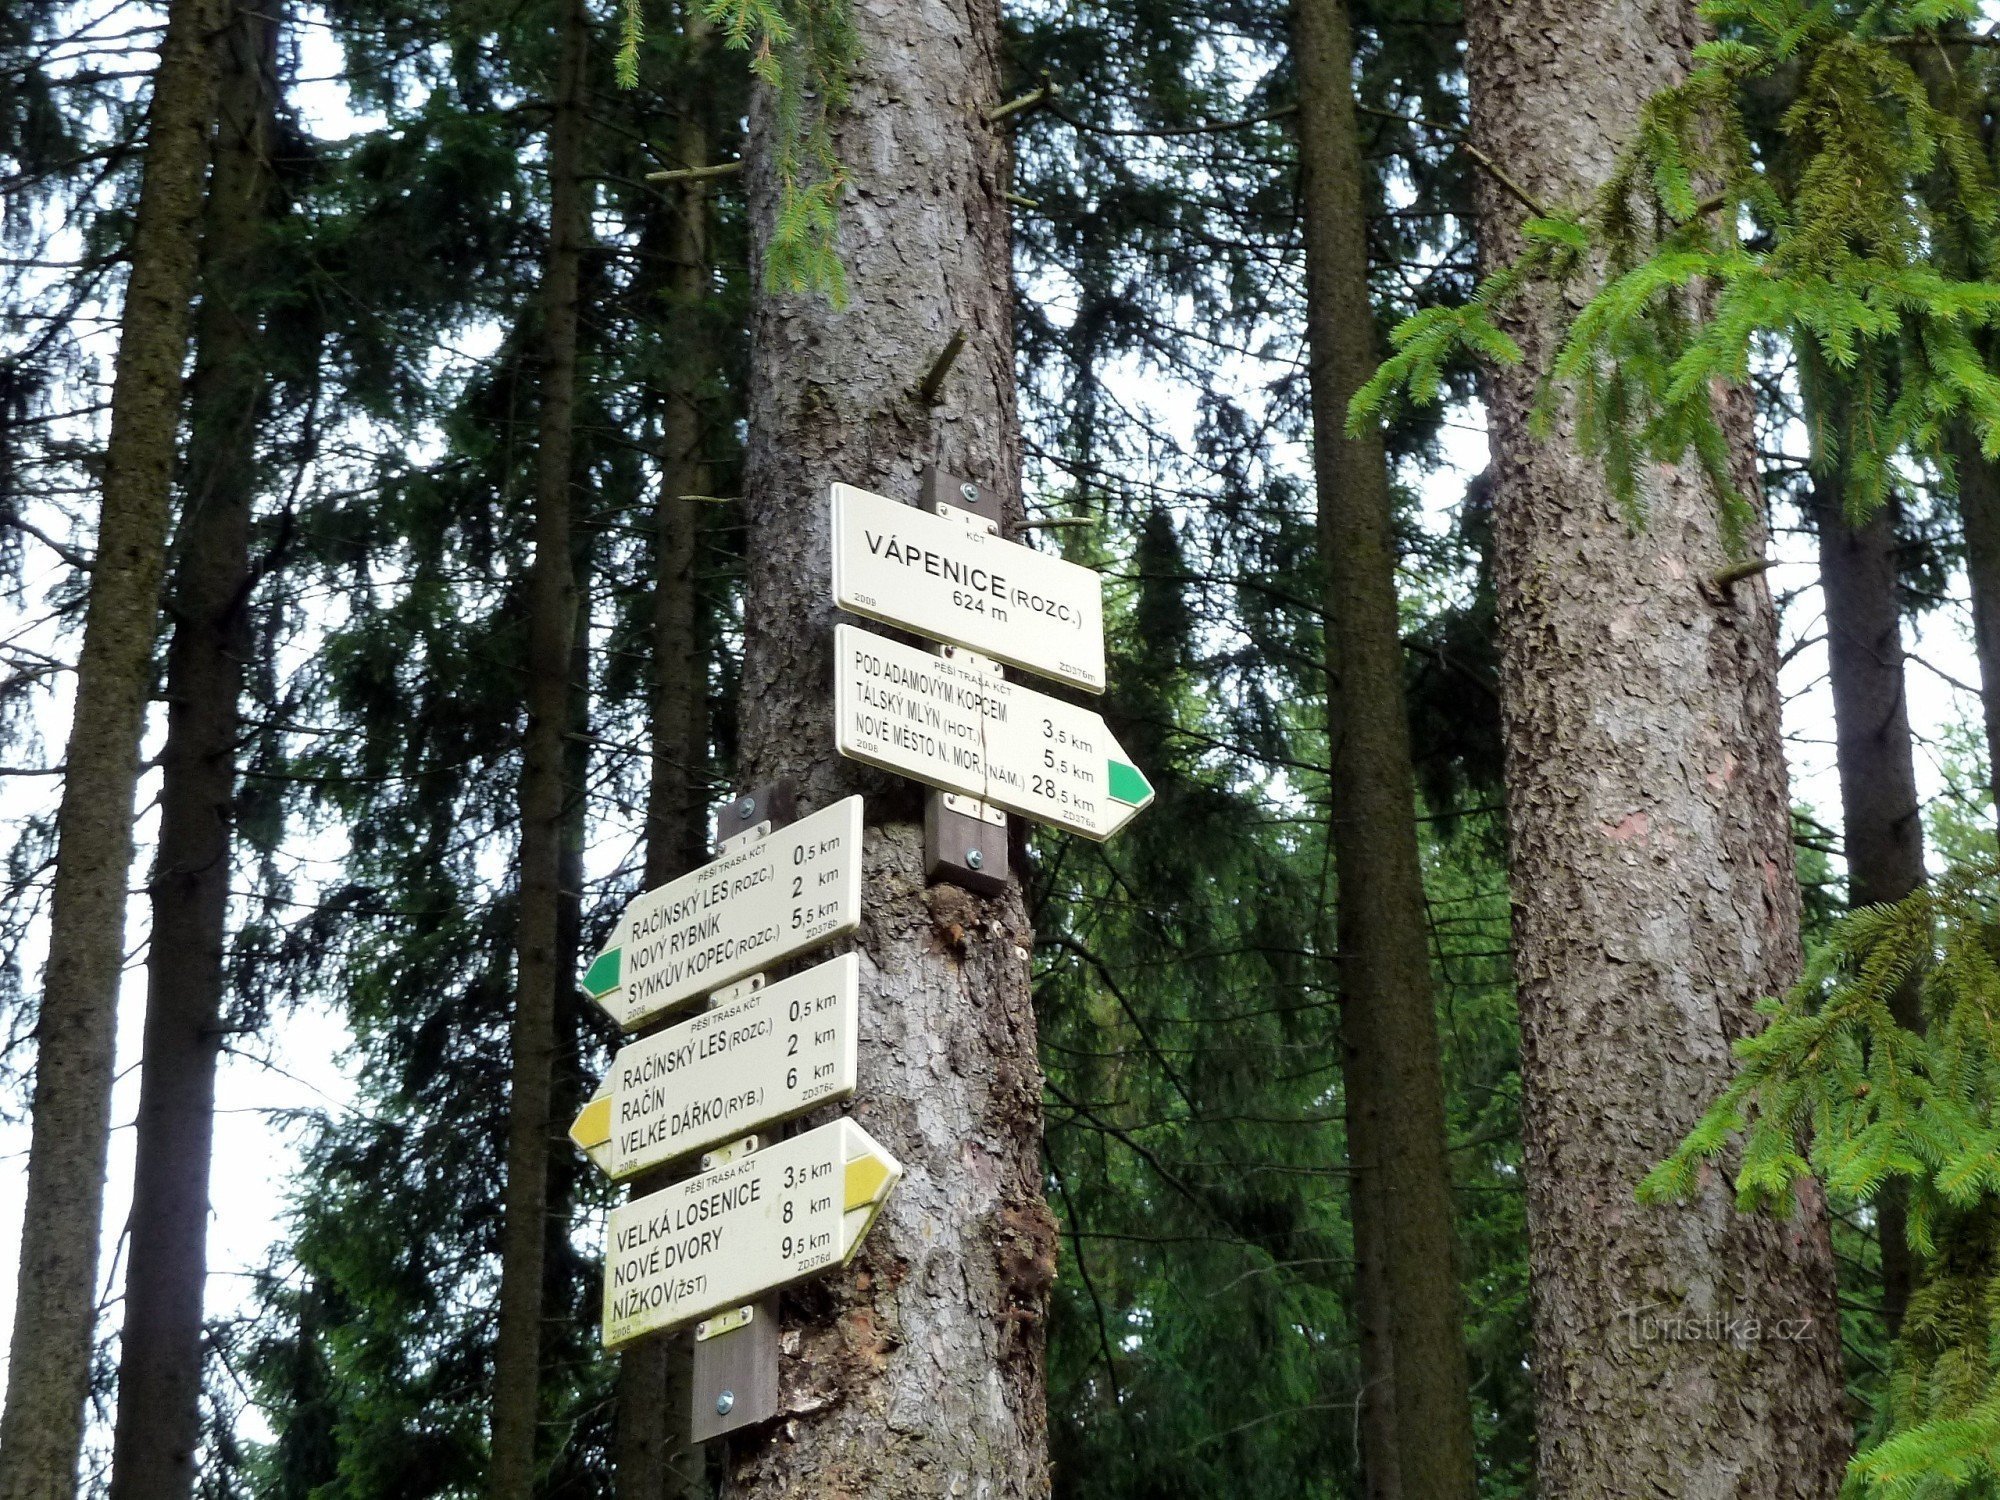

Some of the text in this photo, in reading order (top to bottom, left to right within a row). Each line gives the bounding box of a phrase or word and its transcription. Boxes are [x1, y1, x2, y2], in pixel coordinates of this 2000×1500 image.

[865, 530, 1082, 629] VÁPENICE (ROZC.)
[953, 591, 1008, 622] 624 m
[855, 651, 1093, 753] POD ADAMOVÝM KOPCEM 3,5 km
[856, 680, 1094, 783] TÁLSKÝ MLÝN (HOT.) 5,5 km
[856, 712, 889, 742] NOVÉ
[893, 724, 935, 757] MĚSTO
[938, 741, 950, 763] N.
[953, 746, 985, 775] MOR.
[1032, 775, 1068, 804] 28,5
[1073, 794, 1095, 813] km
[631, 837, 840, 942] RAČÍNSKÝ LES (ROZC.) 0,5 km
[718, 853, 747, 874] TRASA
[629, 868, 839, 973] NOVÝ RYBNÍK 2 km
[629, 900, 839, 1004] SYNKŮV KOPEC (ROZC.) 5,5 km
[623, 994, 837, 1091] RAČÍNSKÝ LES (ROZC.) 0,5 km
[712, 1006, 742, 1024] TRASA
[620, 1062, 835, 1156] VELKÉ DÁŘKO (RYB.) 6 km
[621, 1028, 835, 1124] RAČÍN 2 km
[617, 1161, 832, 1252] VELKÁ LOSENICE 3,5 km
[706, 1171, 736, 1187] TRASA
[614, 1196, 831, 1288] NOVÉ DVORY 8 km
[781, 1236, 804, 1260] 9,5
[809, 1231, 831, 1249] km
